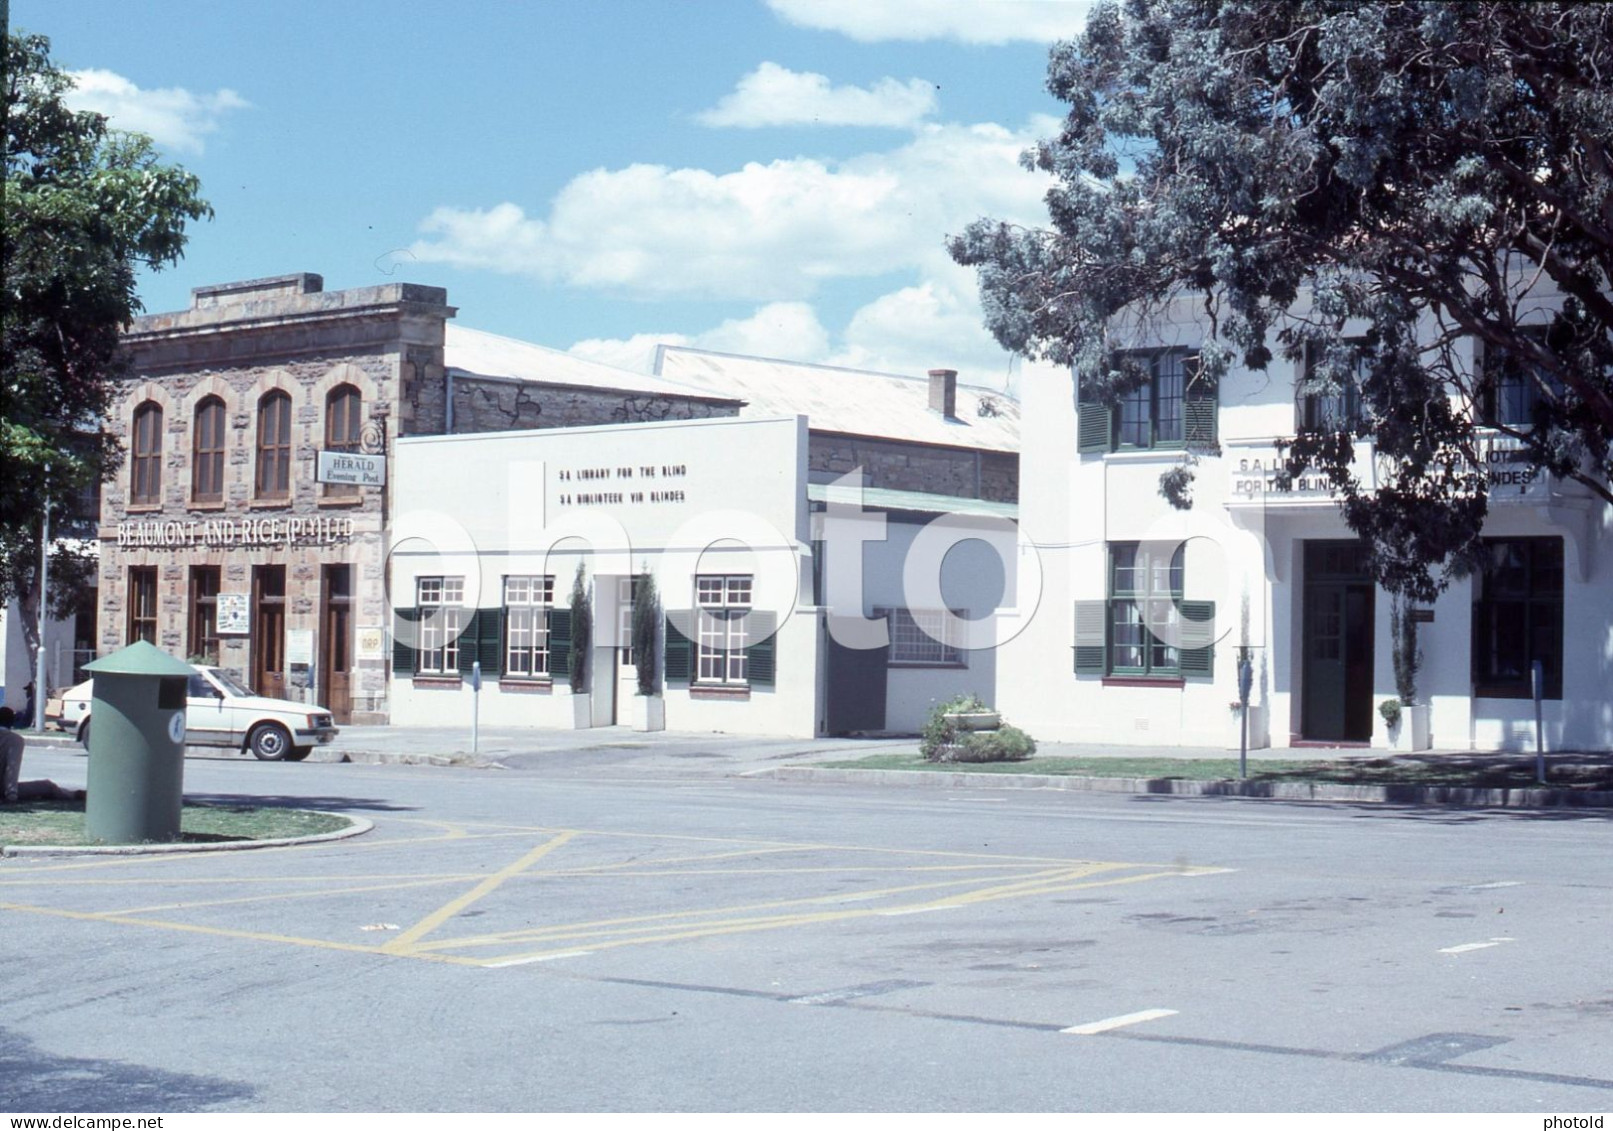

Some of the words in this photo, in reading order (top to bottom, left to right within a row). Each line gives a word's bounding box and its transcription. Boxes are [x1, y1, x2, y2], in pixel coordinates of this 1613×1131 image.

[333, 459, 375, 470] HERALD
[327, 469, 357, 482] Evening
[362, 472, 379, 483] Post
[577, 468, 610, 480] LIBRARY
[617, 467, 633, 478] FOR
[640, 466, 655, 478] THE
[662, 464, 687, 477] BLIND
[1236, 479, 1262, 493] FOR
[577, 493, 623, 504] BIBLIOTEEK
[631, 492, 643, 503] VIR
[651, 490, 686, 503] BLINDES
[117, 521, 197, 546] BEAUMONT
[201, 520, 235, 545] AND
[241, 519, 280, 544] RICE
[286, 517, 322, 544] (PTY)
[326, 518, 355, 543] LTD
